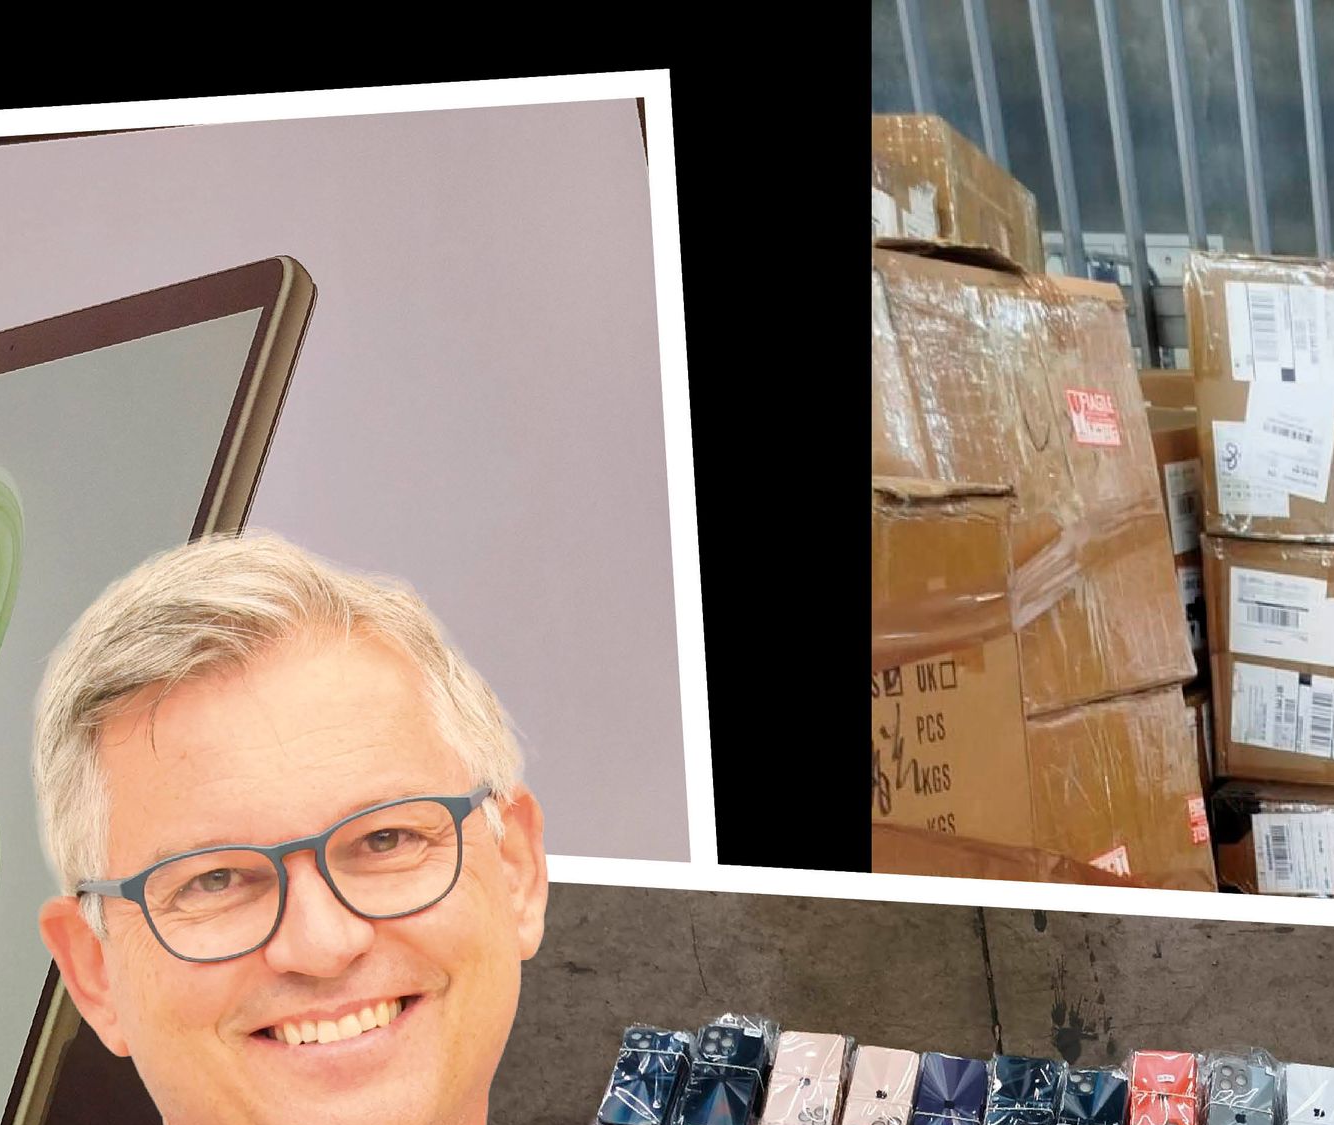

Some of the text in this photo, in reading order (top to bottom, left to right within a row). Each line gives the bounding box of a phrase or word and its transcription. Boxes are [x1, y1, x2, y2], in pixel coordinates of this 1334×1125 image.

[917, 663, 938, 693] UK
[916, 713, 946, 744] PCS
[921, 764, 952, 796] KGS
